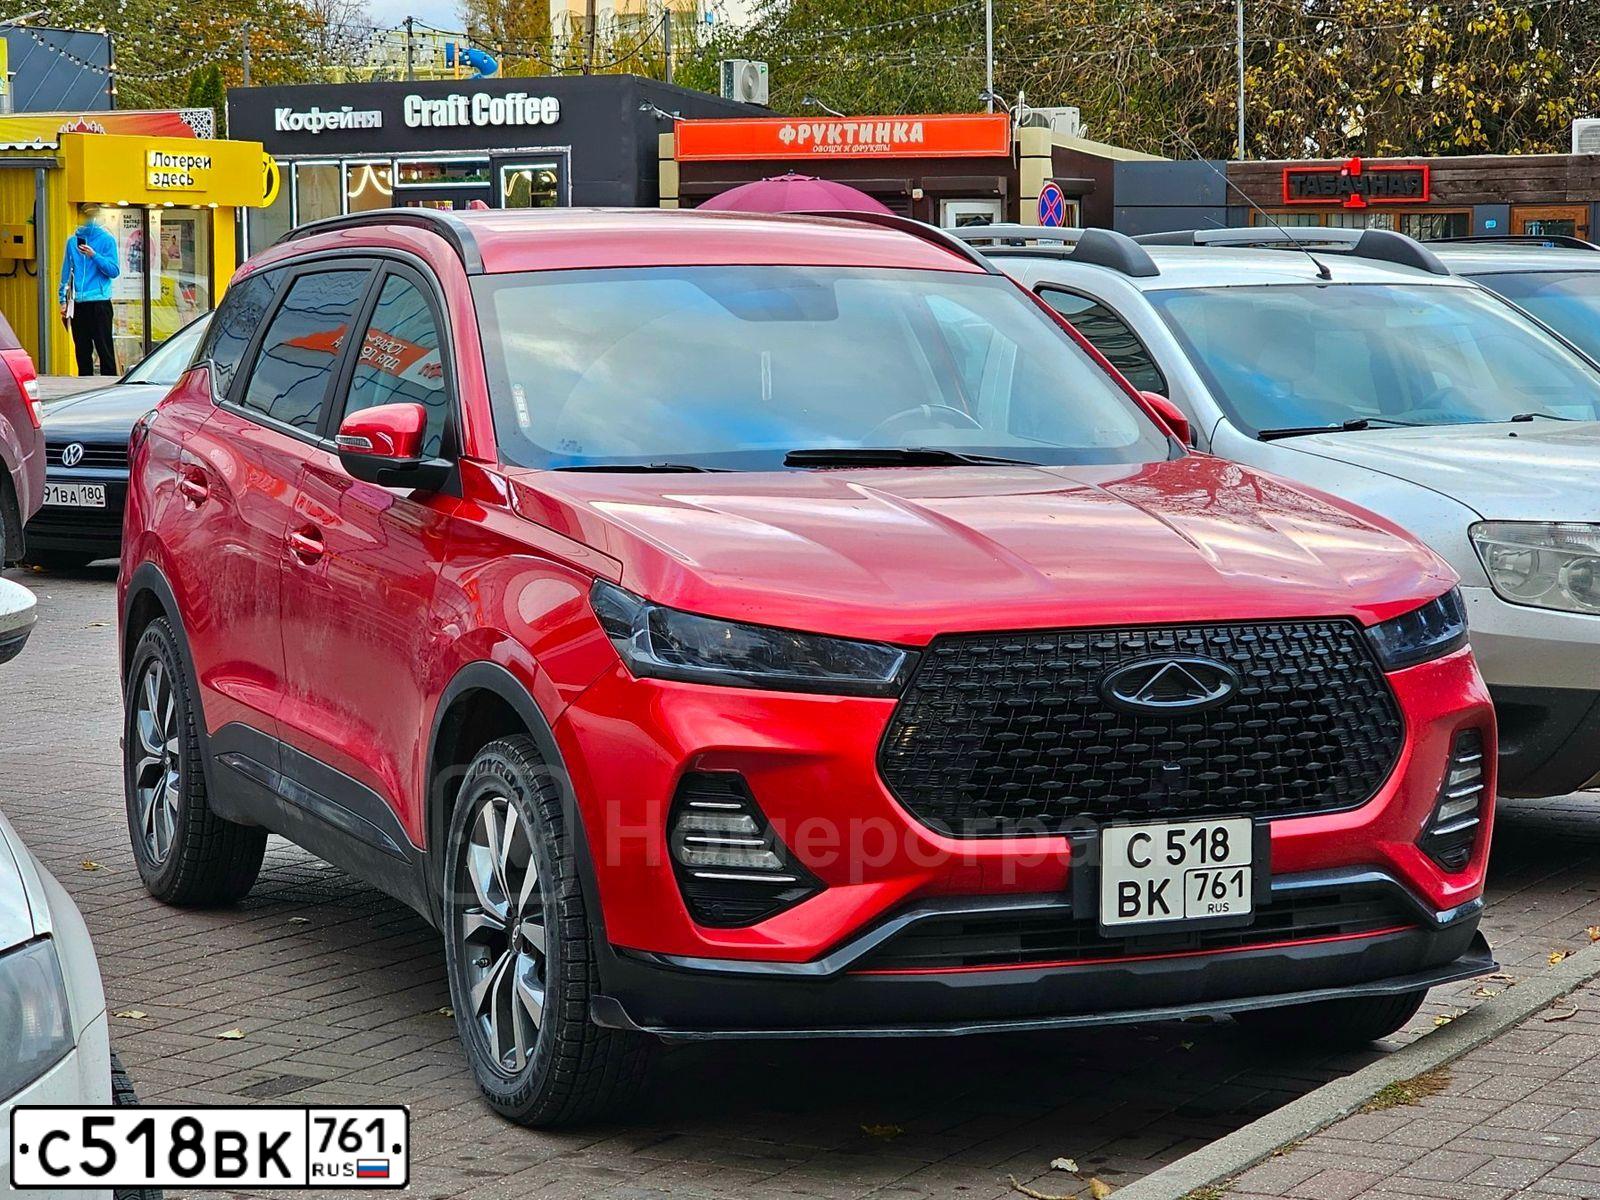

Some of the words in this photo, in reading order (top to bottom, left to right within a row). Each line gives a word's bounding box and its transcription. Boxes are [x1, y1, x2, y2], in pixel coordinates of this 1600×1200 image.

[274, 106, 383, 134] Кофейня
[403, 94, 470, 128] Craft
[471, 92, 560, 126] Coffee
[778, 121, 924, 145] ФРУКТИНКА
[812, 144, 842, 154] ОВОЩИ
[851, 143, 891, 153] ФРУКТЫ
[153, 152, 212, 171] Лотереи
[153, 172, 195, 186] здесь
[1290, 175, 1423, 196] ТАБАЧНАЯ
[81, 486, 102, 500] 180
[1166, 826, 1230, 866] 518
[1194, 870, 1244, 901] 761
[1207, 902, 1230, 914] RUS
